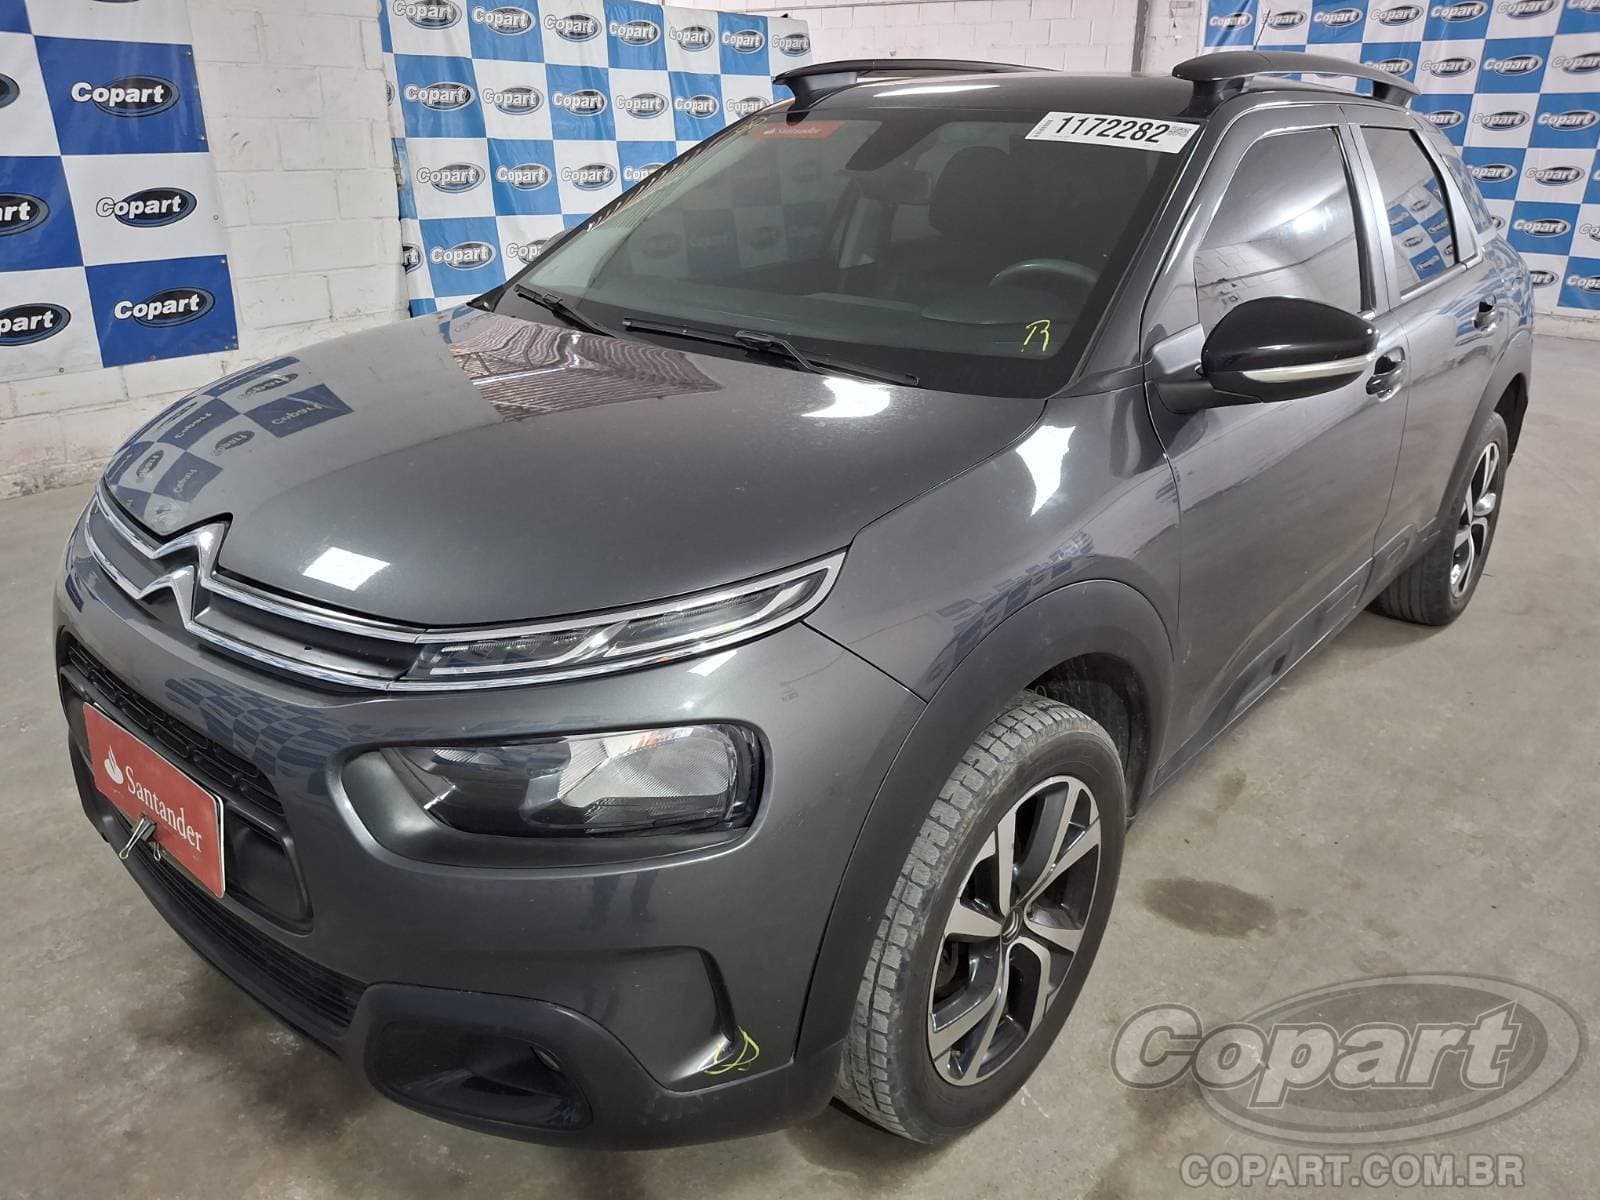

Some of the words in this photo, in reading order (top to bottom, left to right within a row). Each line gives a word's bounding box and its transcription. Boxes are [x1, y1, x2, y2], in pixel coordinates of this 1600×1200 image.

[393, 0, 453, 20] Copart
[1371, 8, 1417, 21] Copart
[1431, 3, 1480, 18] Copart
[1497, 0, 1550, 15] Copart
[473, 7, 528, 28] Copart
[544, 15, 594, 35] Copart
[1209, 13, 1247, 27] Copart
[1314, 10, 1357, 26] Copart
[610, 22, 656, 40] Copart
[670, 27, 708, 44] Copart
[722, 32, 761, 47] Copart
[772, 36, 809, 49] Copart
[1422, 60, 1469, 72] Copart
[1484, 57, 1534, 71] Copart
[71, 82, 164, 107] Copart
[405, 84, 466, 104] Copart
[483, 88, 537, 107] Copart
[553, 92, 602, 109] Copart
[616, 95, 661, 112] Copart
[675, 97, 715, 112] Copart
[1472, 113, 1521, 127] Copart
[1537, 112, 1592, 126] Copart
[1055, 115, 1171, 143] 1172282
[417, 167, 475, 185] Copart
[497, 167, 545, 184] Copart
[562, 166, 609, 185] Copart
[623, 167, 651, 182] Cop
[1471, 167, 1509, 179] opart
[1525, 167, 1577, 182] Copart
[96, 195, 182, 218] Copart
[1513, 219, 1565, 233] Copart
[431, 245, 488, 265] Copart
[506, 243, 541, 259] Cop
[114, 293, 199, 320] Copart
[0, 310, 54, 336] part
[125, 766, 203, 852] Santander
